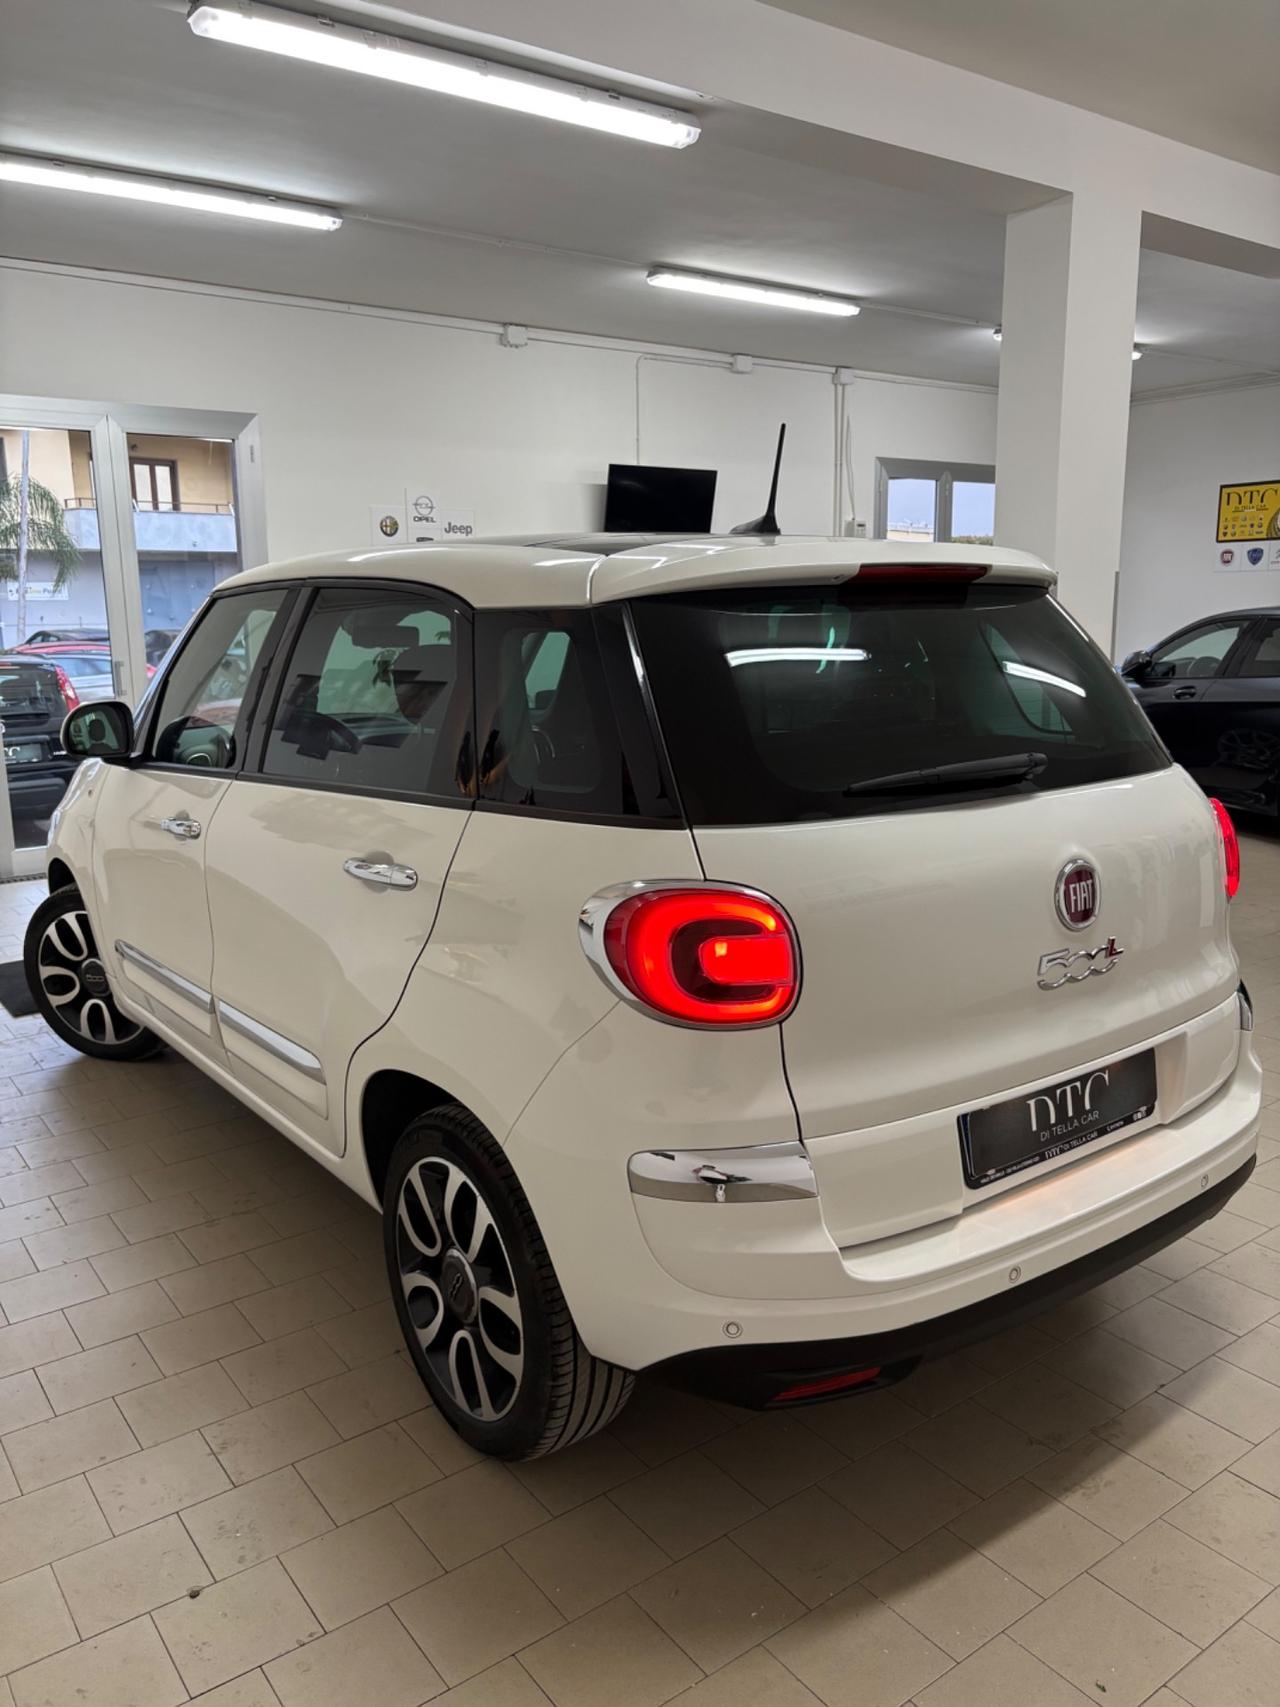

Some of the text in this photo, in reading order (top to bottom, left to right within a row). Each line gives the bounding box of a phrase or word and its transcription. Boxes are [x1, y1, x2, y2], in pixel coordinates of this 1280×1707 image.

[1226, 488, 1278, 506] DTC
[413, 515, 437, 523] OPEL
[444, 521, 473, 537] Jeep
[1069, 879, 1093, 913] FIAT
[1026, 1069, 1110, 1132] DTC
[1040, 1110, 1100, 1142] DI TELLA CAR
